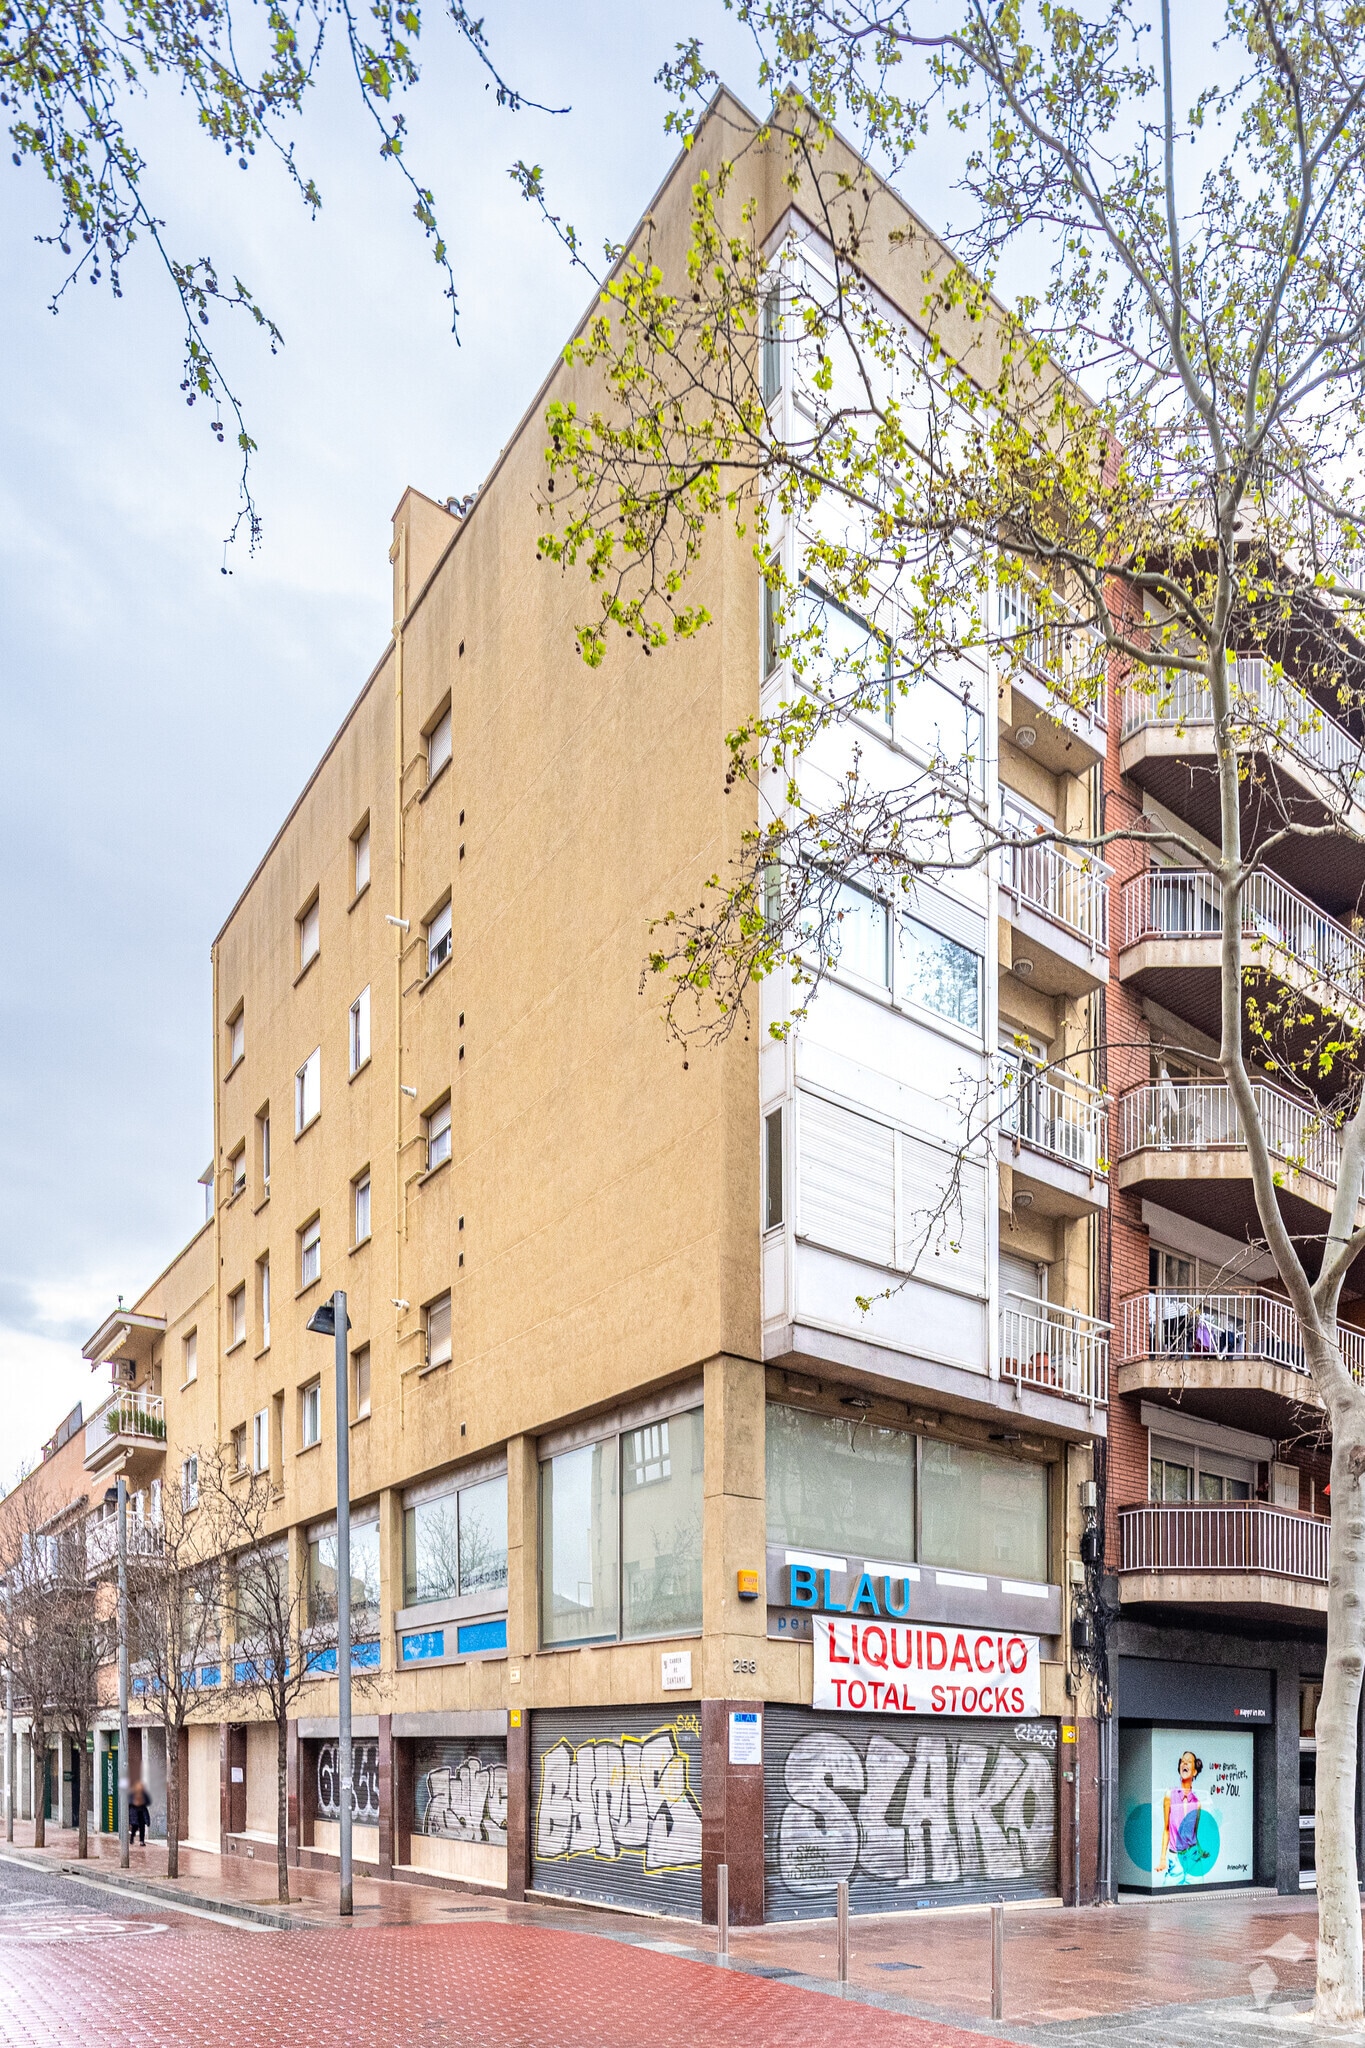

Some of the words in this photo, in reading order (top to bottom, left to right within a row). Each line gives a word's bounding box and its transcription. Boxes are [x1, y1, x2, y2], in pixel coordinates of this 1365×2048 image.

[787, 1564, 911, 1618] BLAU
[733, 1658, 757, 1674] 258
[831, 1678, 916, 1711] TOTAL
[931, 1684, 1025, 1713] STOCKS
[734, 1713, 758, 1723] BLAU
